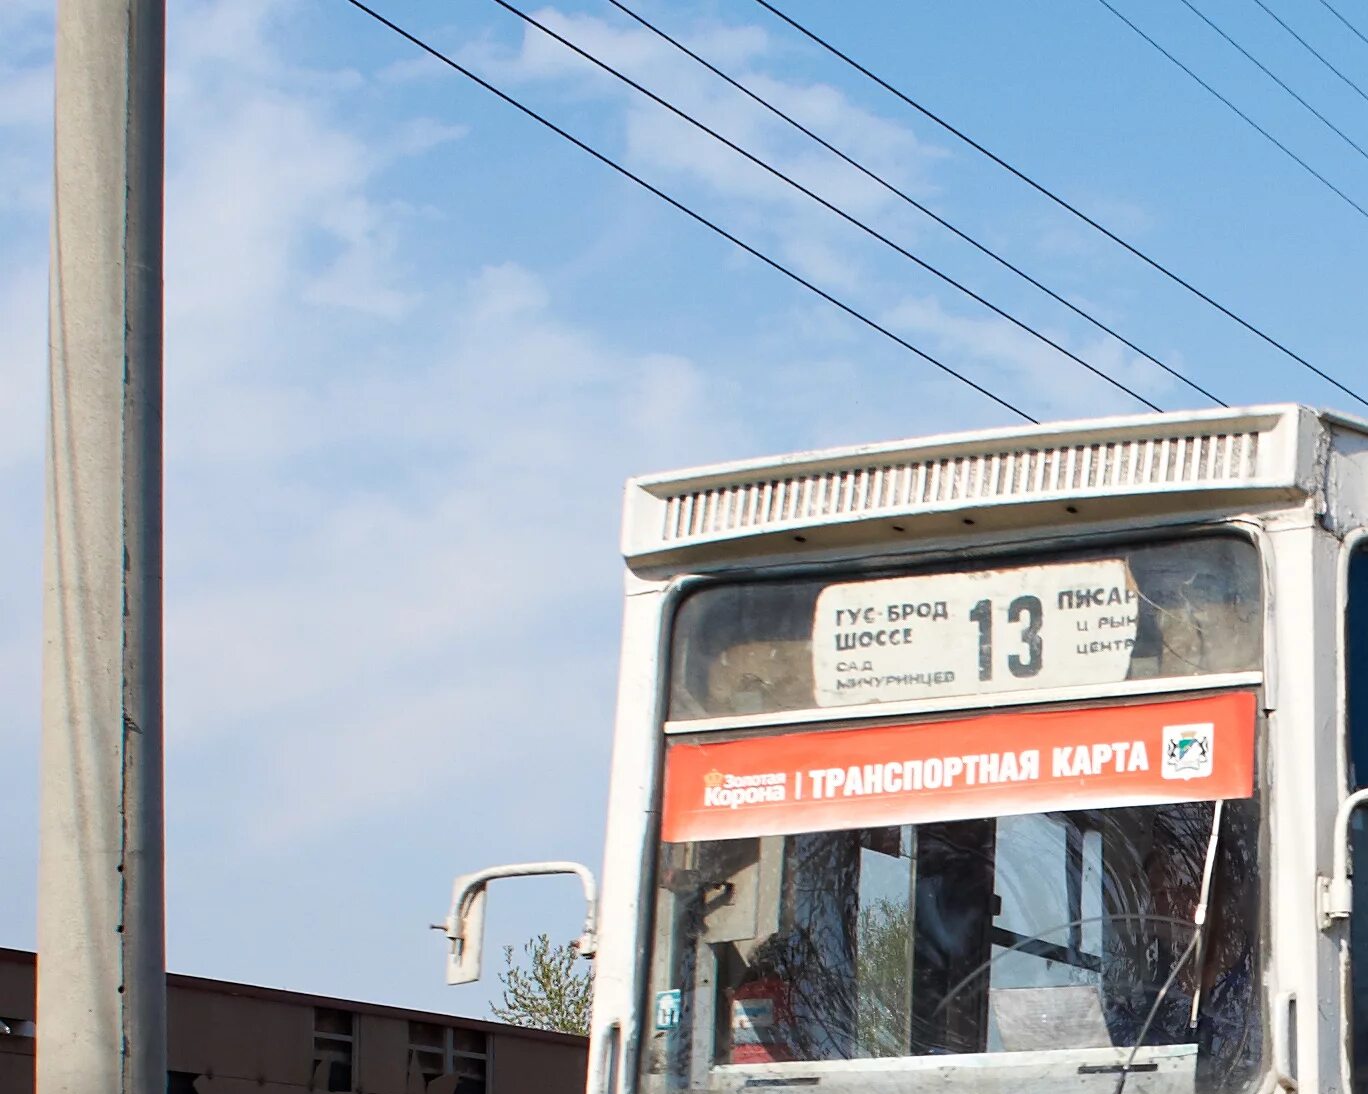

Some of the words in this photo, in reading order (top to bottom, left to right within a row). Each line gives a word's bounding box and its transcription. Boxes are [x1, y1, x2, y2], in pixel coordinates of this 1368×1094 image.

[835, 627, 913, 651] ШОССЕ
[969, 595, 1043, 682] 13
[836, 660, 873, 672] САД
[808, 750, 1039, 799] ТРАНСПОРТНАЯ
[1052, 740, 1149, 778] КАРТА
[704, 785, 785, 810] Корона
